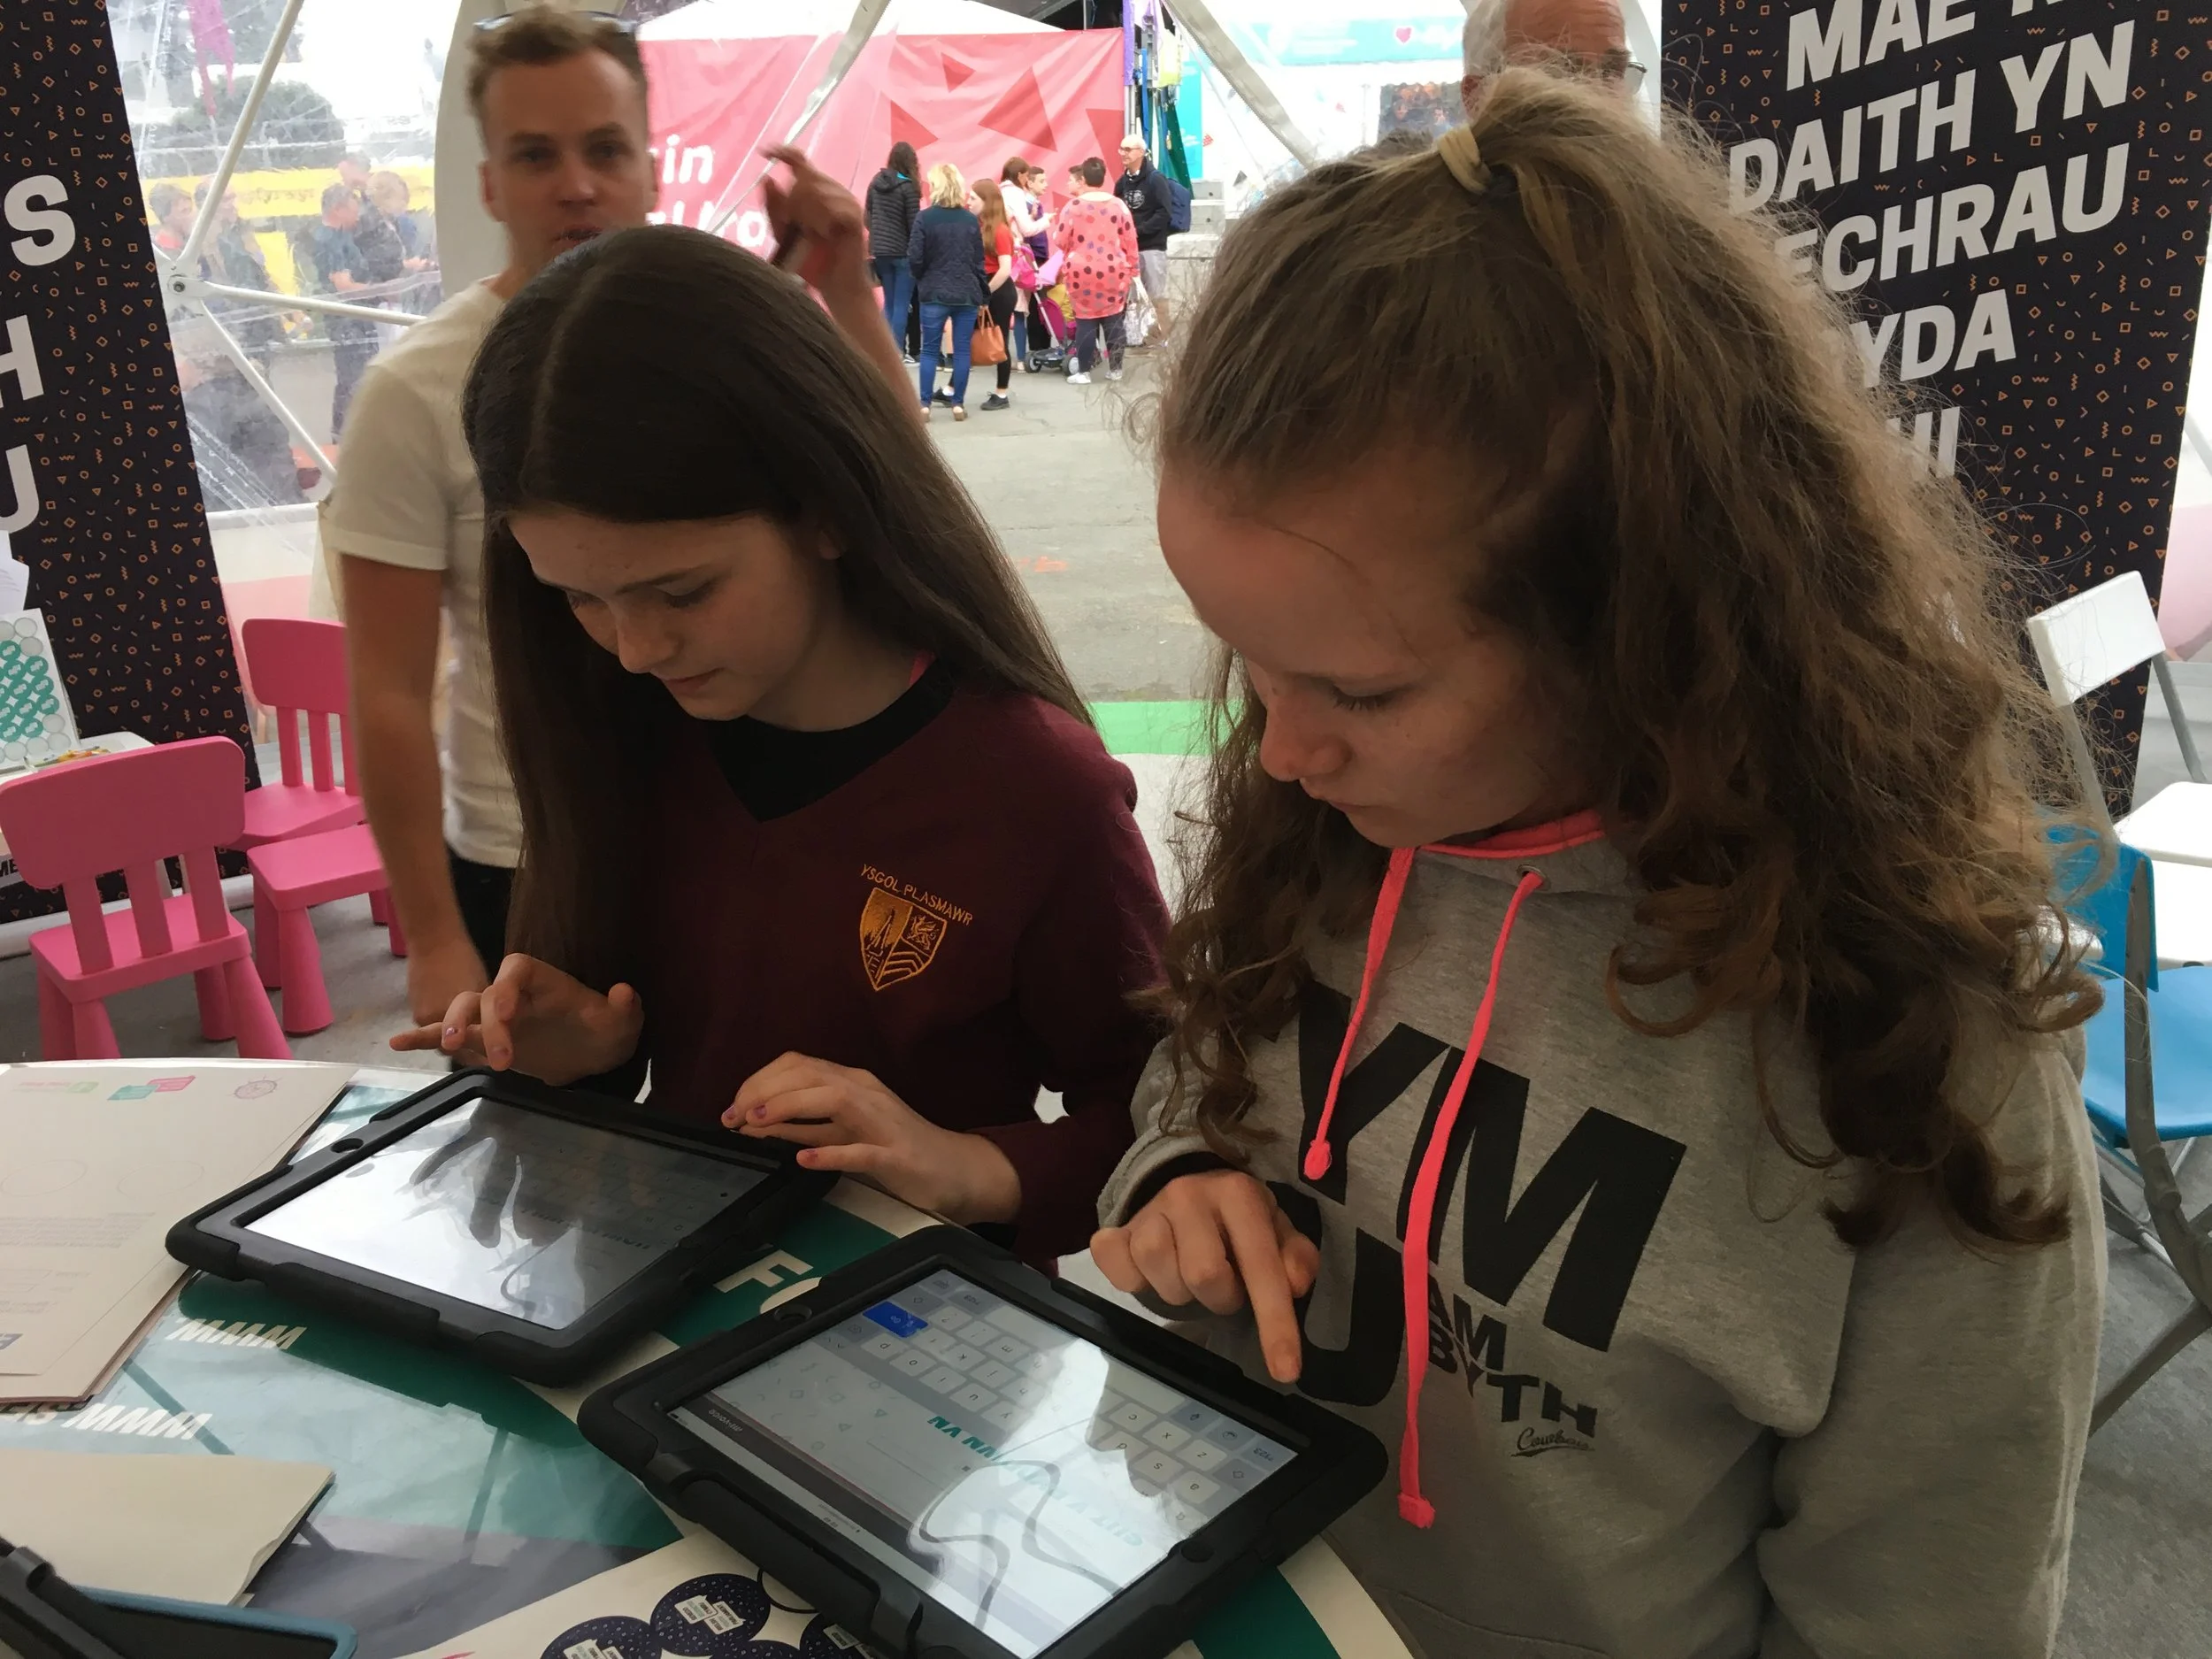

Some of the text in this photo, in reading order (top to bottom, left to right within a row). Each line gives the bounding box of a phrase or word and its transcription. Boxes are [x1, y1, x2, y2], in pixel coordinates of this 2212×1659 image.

[649, 134, 713, 184] in
[1729, 19, 2135, 214] DAITH YN
[1773, 142, 2130, 297] ECHRAU
[1849, 288, 2016, 388] YDA
[860, 863, 974, 926] YSGOL PLASMAWR
